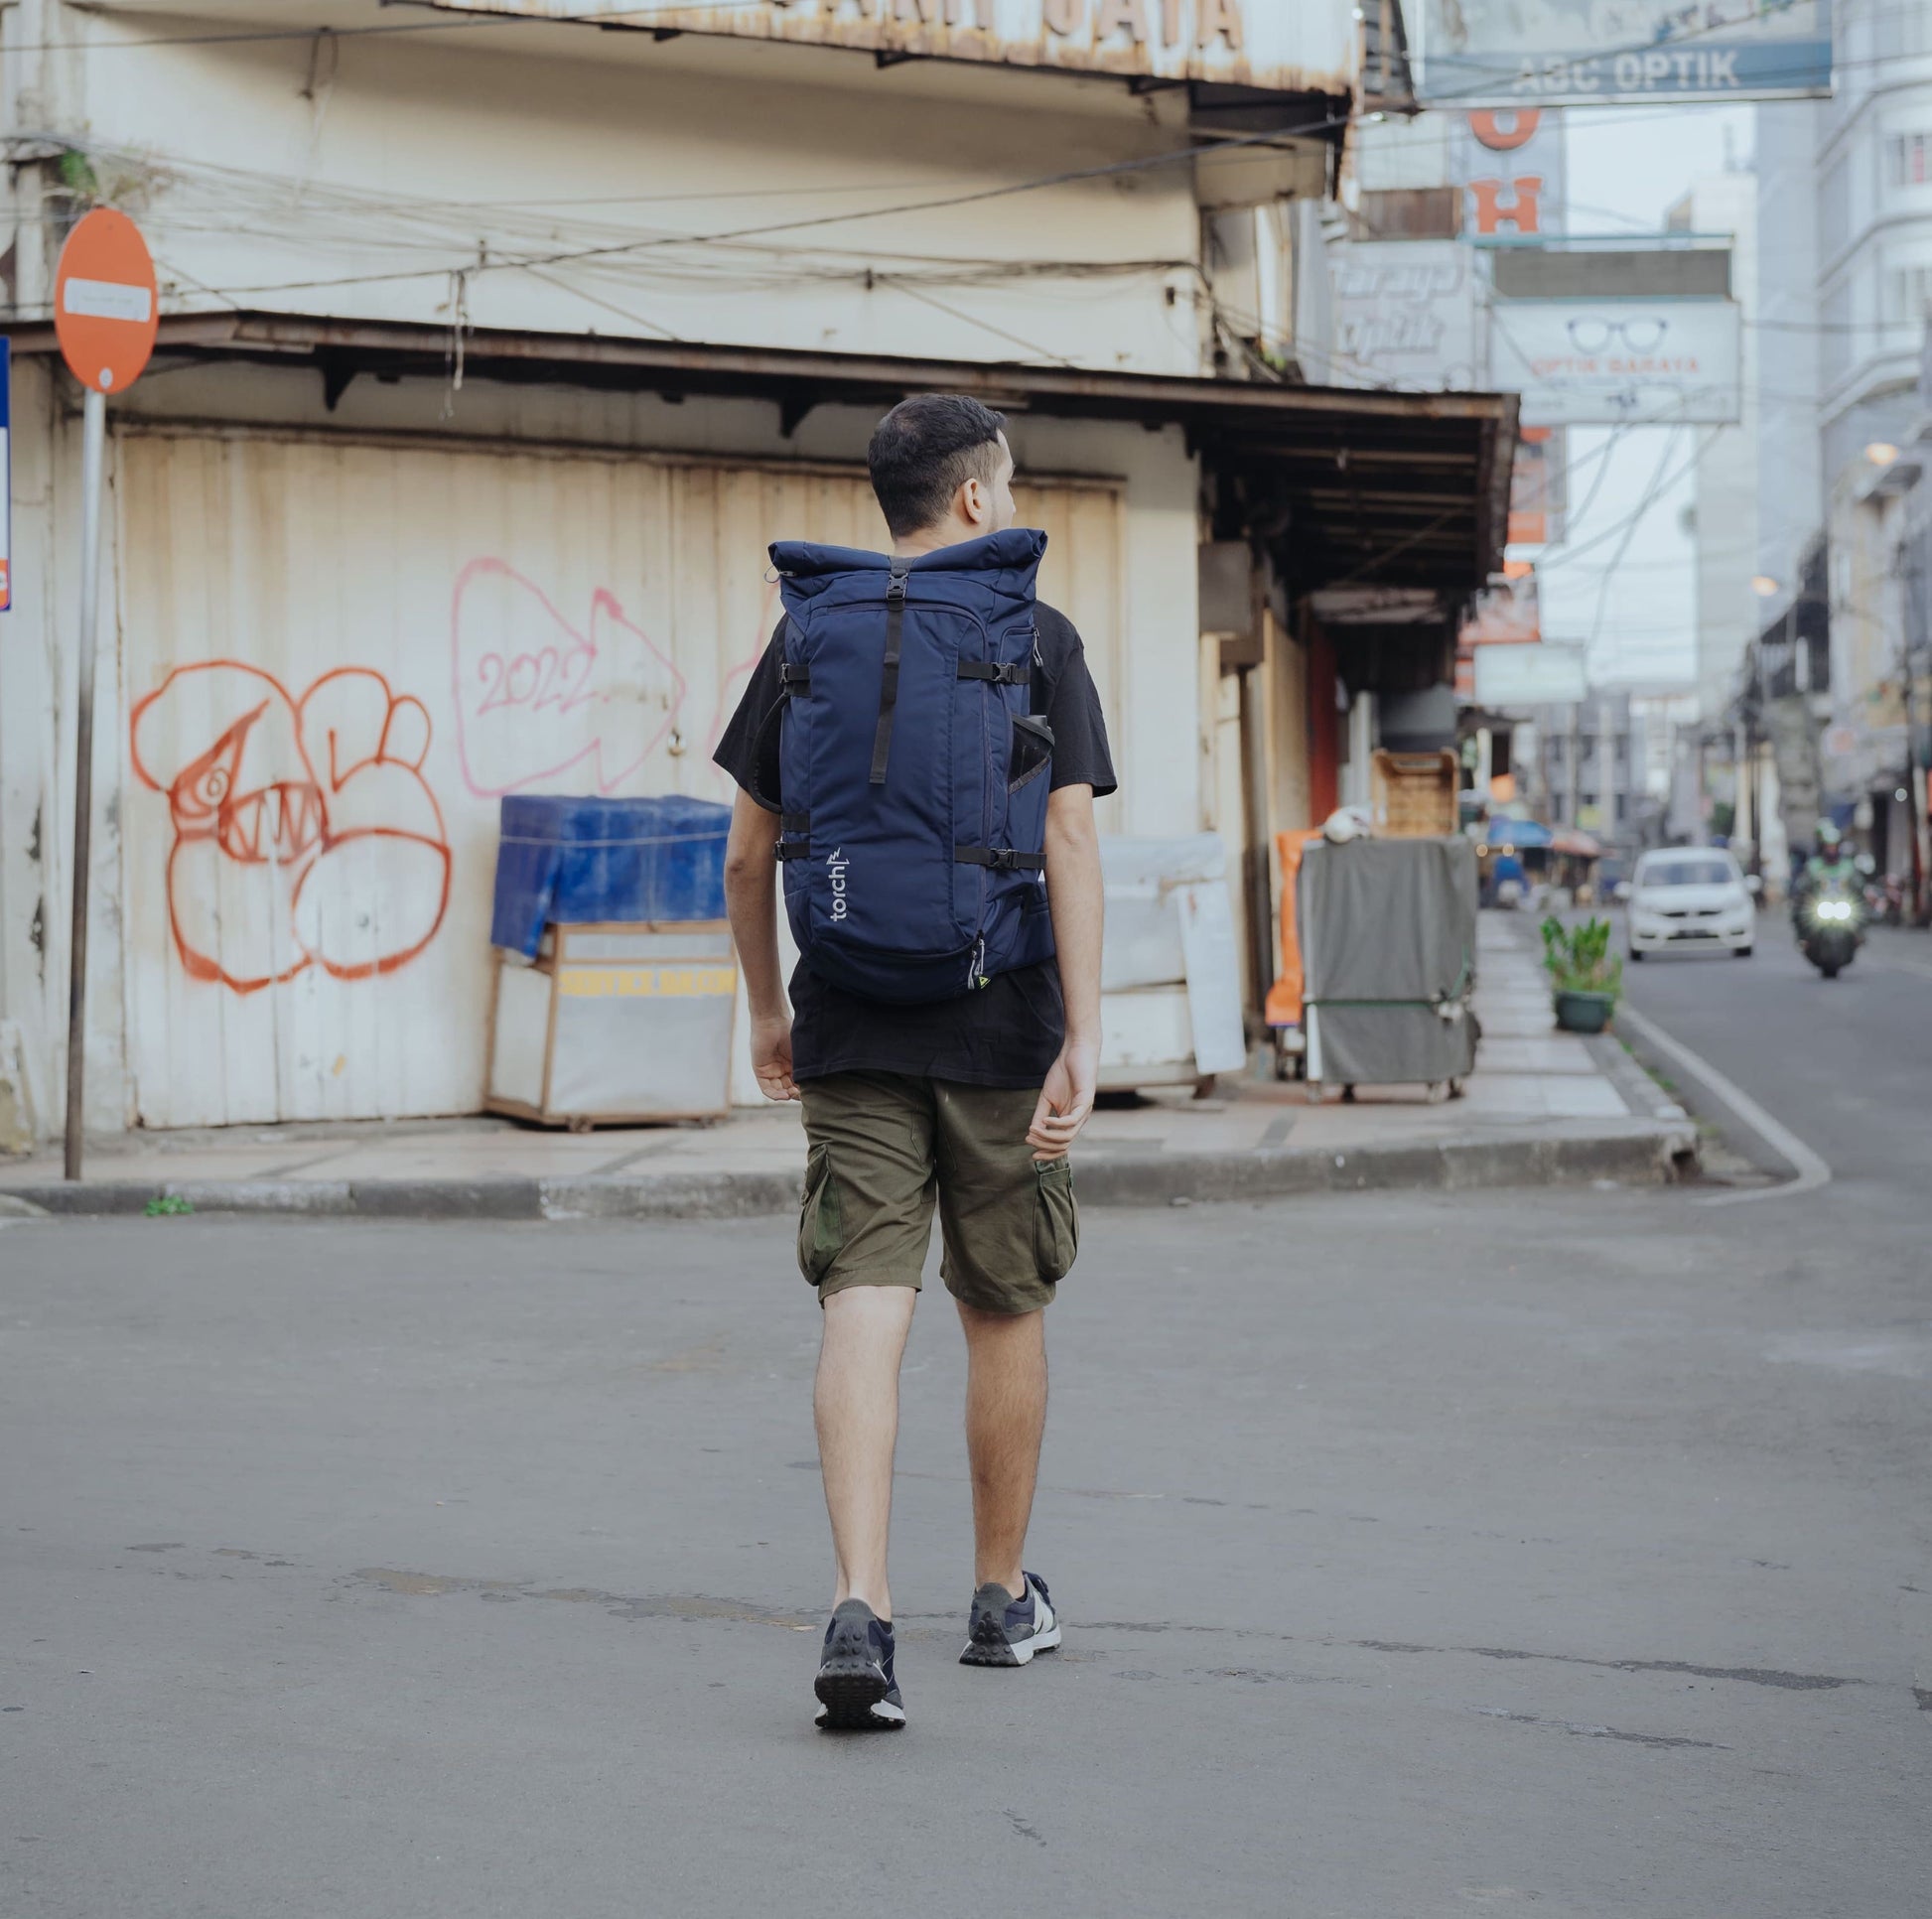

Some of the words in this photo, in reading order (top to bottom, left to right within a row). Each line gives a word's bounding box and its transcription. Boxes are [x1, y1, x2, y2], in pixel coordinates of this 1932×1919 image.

[1511, 56, 1600, 93] ABC
[1613, 51, 1740, 91] OPTIK
[828, 866, 847, 922] torch
